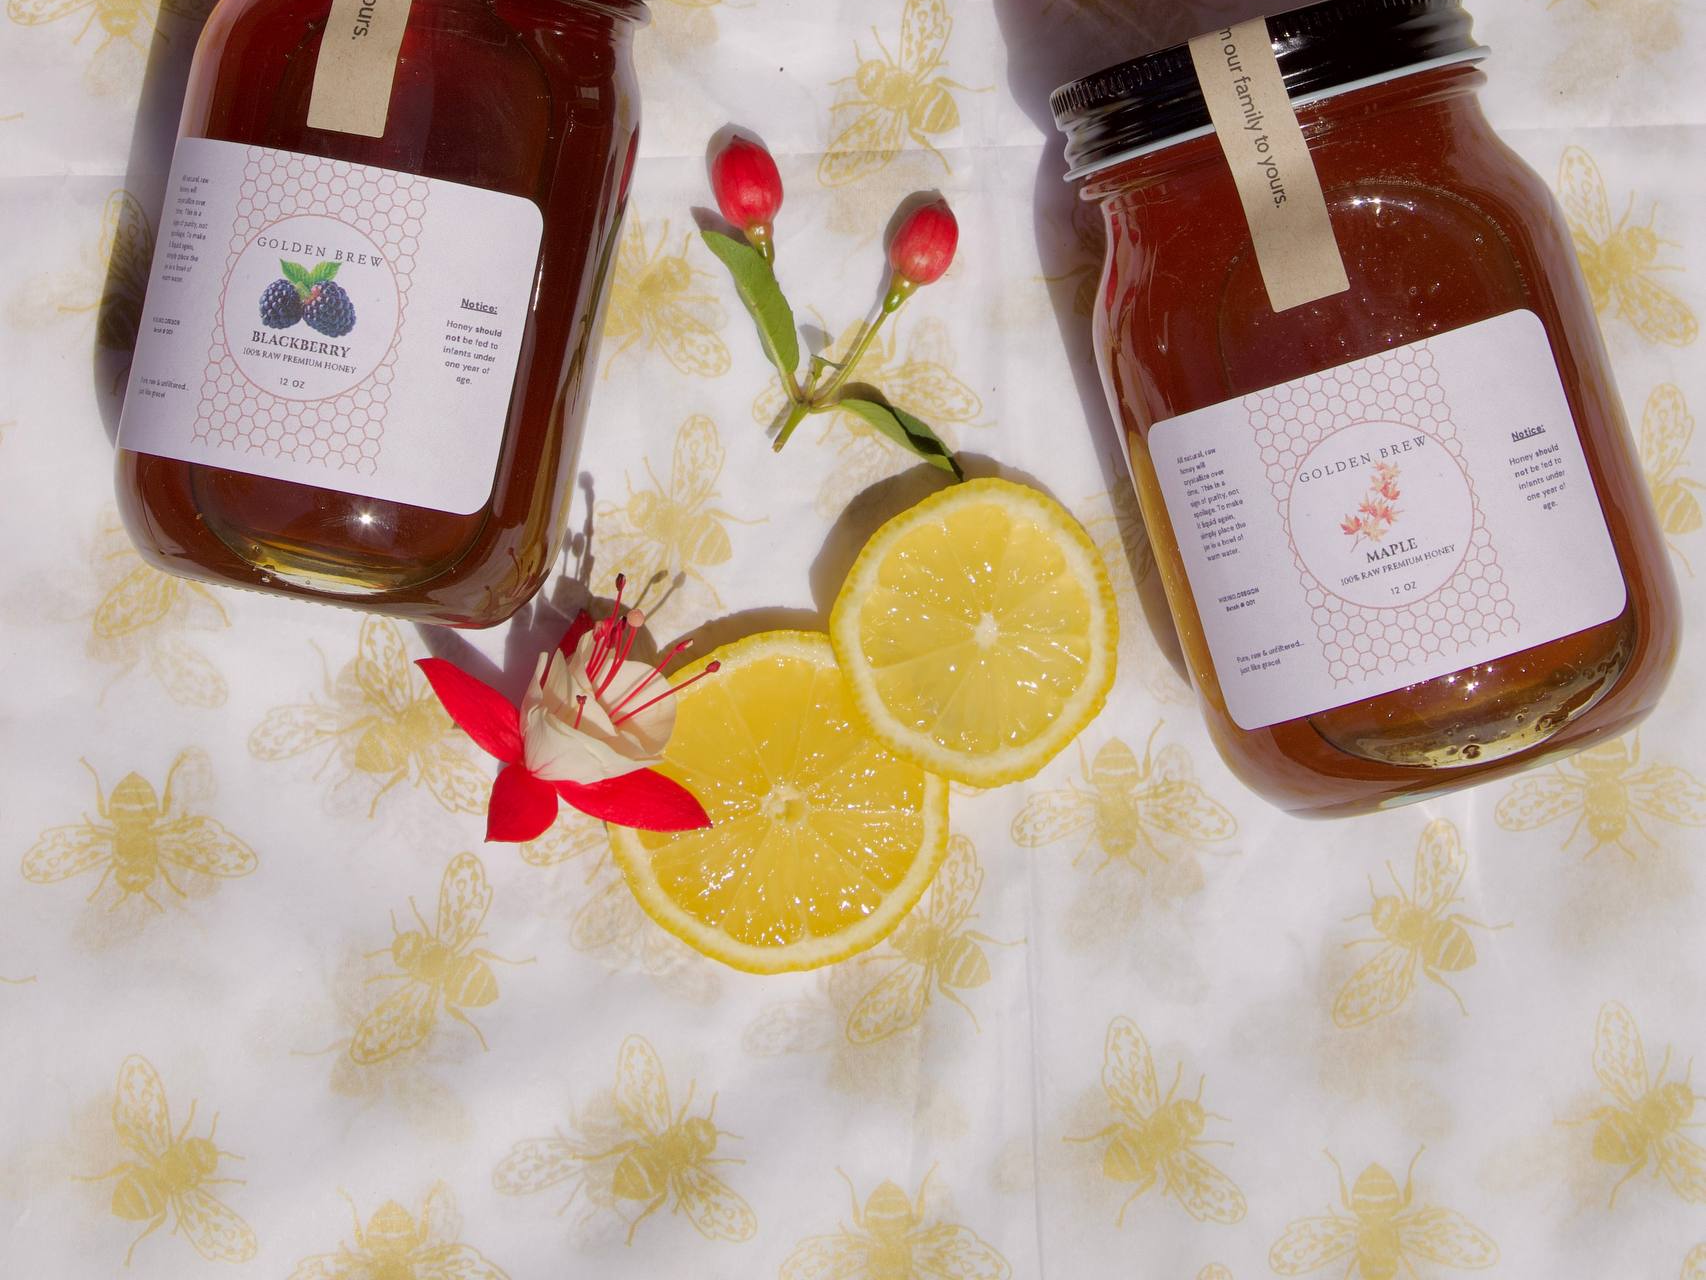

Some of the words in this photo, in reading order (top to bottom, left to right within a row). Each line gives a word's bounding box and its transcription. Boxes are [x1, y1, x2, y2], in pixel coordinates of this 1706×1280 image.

[1224, 44, 1242, 72] our
[1234, 76, 1264, 130] family
[1254, 135, 1269, 153] to
[1257, 156, 1287, 209] yours.
[257, 236, 327, 257] GOLDEN
[335, 250, 383, 268] BREW
[461, 298, 497, 315] Notice:
[447, 320, 473, 332] Honey
[476, 326, 502, 337] should
[251, 331, 351, 358] BLACKBERRY
[445, 334, 460, 342] not
[463, 336, 473, 345] be
[476, 339, 488, 348] fed
[243, 347, 260, 357] 100%
[262, 350, 281, 360] RAW
[283, 354, 322, 368] PREMIUM
[324, 362, 356, 374] HONEY
[443, 346, 471, 357] infants
[474, 353, 495, 362] under
[463, 364, 479, 372] year
[292, 380, 305, 389] OZ
[1512, 424, 1546, 442] Notice:
[1300, 453, 1371, 483] GOLDEN
[1380, 435, 1426, 458] BREW
[1509, 453, 1533, 466] Honey
[1535, 443, 1559, 457] should
[1515, 468, 1528, 478] not
[1530, 465, 1539, 473] be
[1555, 457, 1561, 465] to
[1519, 477, 1544, 490] infants
[1546, 470, 1565, 481] under
[1527, 493, 1540, 501] one
[1543, 487, 1557, 497] year
[1366, 538, 1418, 563] MAPLE
[1341, 575, 1360, 586] 100%
[1361, 568, 1380, 580] RAW
[1383, 555, 1423, 573] PREMIUM
[1425, 544, 1455, 560] HONEY
[1391, 587, 1400, 595] 12
[1404, 582, 1416, 591] OZ
